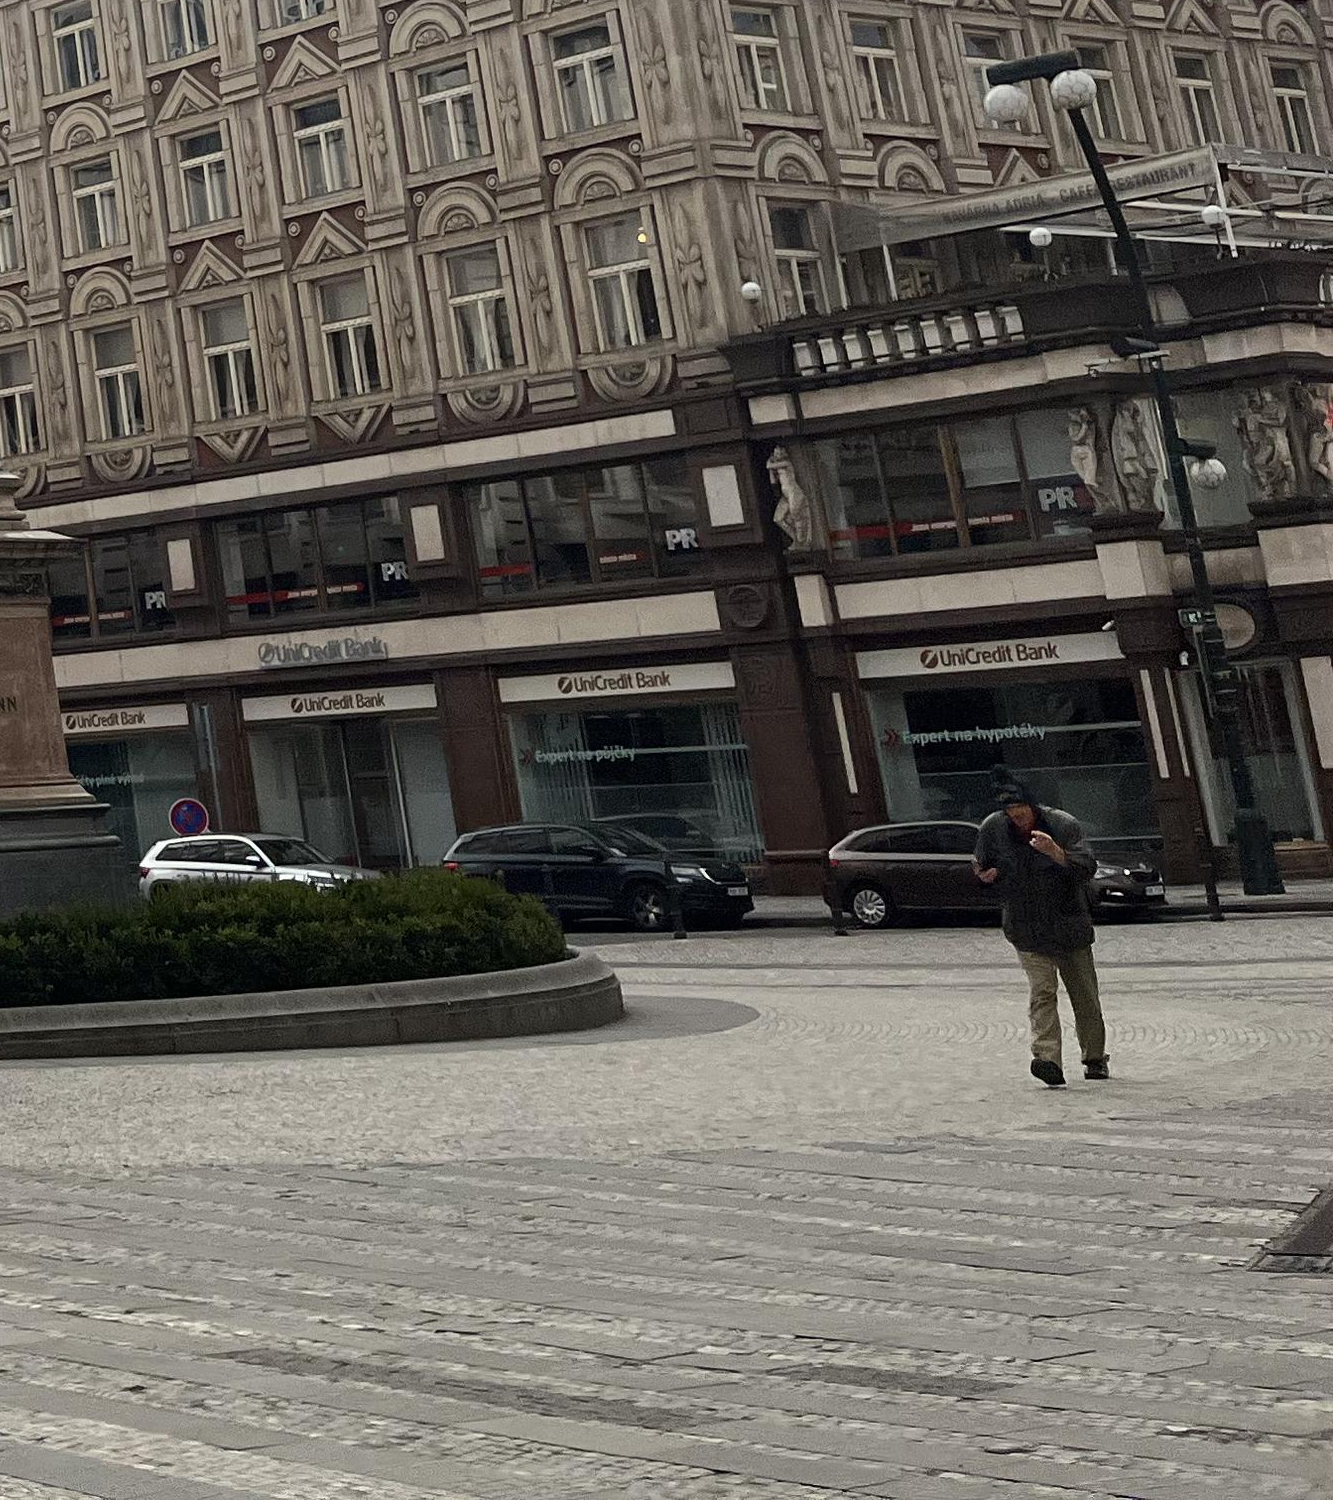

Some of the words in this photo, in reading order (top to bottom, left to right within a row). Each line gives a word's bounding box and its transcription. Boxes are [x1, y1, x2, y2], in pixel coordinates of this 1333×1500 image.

[275, 638, 340, 663] UniCredit
[341, 636, 384, 658] Bank
[939, 645, 1013, 667] UniCredit
[1016, 642, 1060, 661] Bank
[574, 674, 634, 692] UniCredit
[636, 671, 671, 689] Bank
[304, 695, 354, 712] UniCredit
[355, 693, 386, 708] Bank
[77, 712, 120, 728] UniCredit
[121, 710, 146, 725] Bank
[902, 729, 951, 746] Expert
[954, 731, 973, 742] na
[976, 723, 1046, 743] hypotéky
[535, 749, 574, 765] Expert
